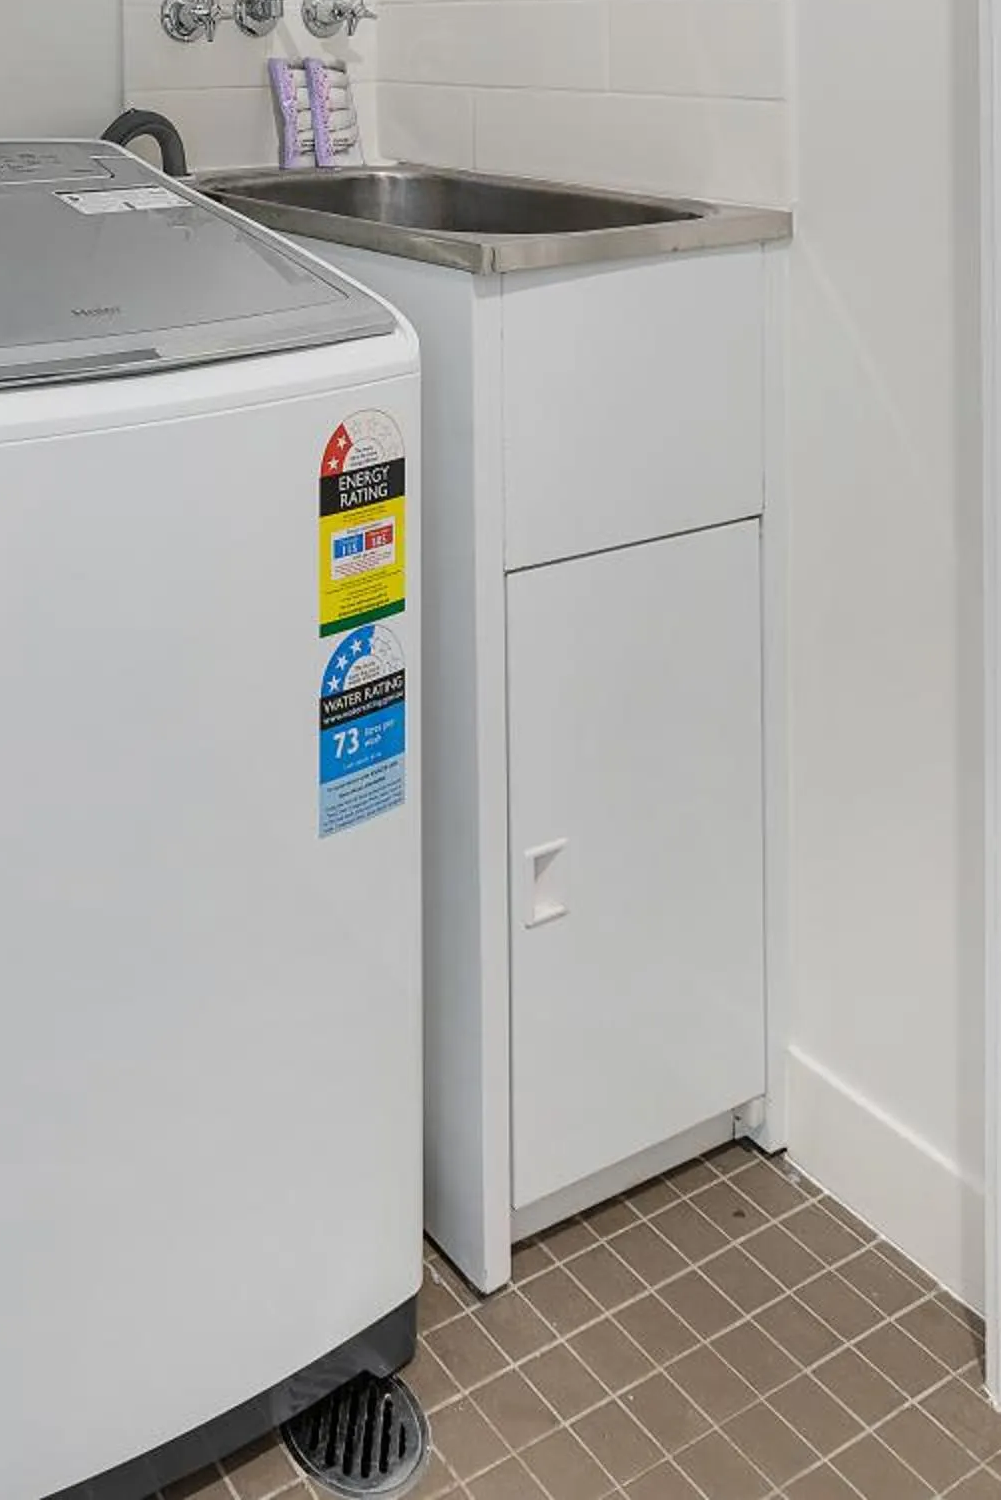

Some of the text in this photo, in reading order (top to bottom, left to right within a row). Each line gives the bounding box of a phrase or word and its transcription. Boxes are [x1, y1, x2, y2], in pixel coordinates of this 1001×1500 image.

[339, 464, 390, 491] ENERGY
[340, 482, 388, 509] RATING
[322, 675, 404, 713] WATER RATING
[333, 727, 359, 758] 73
